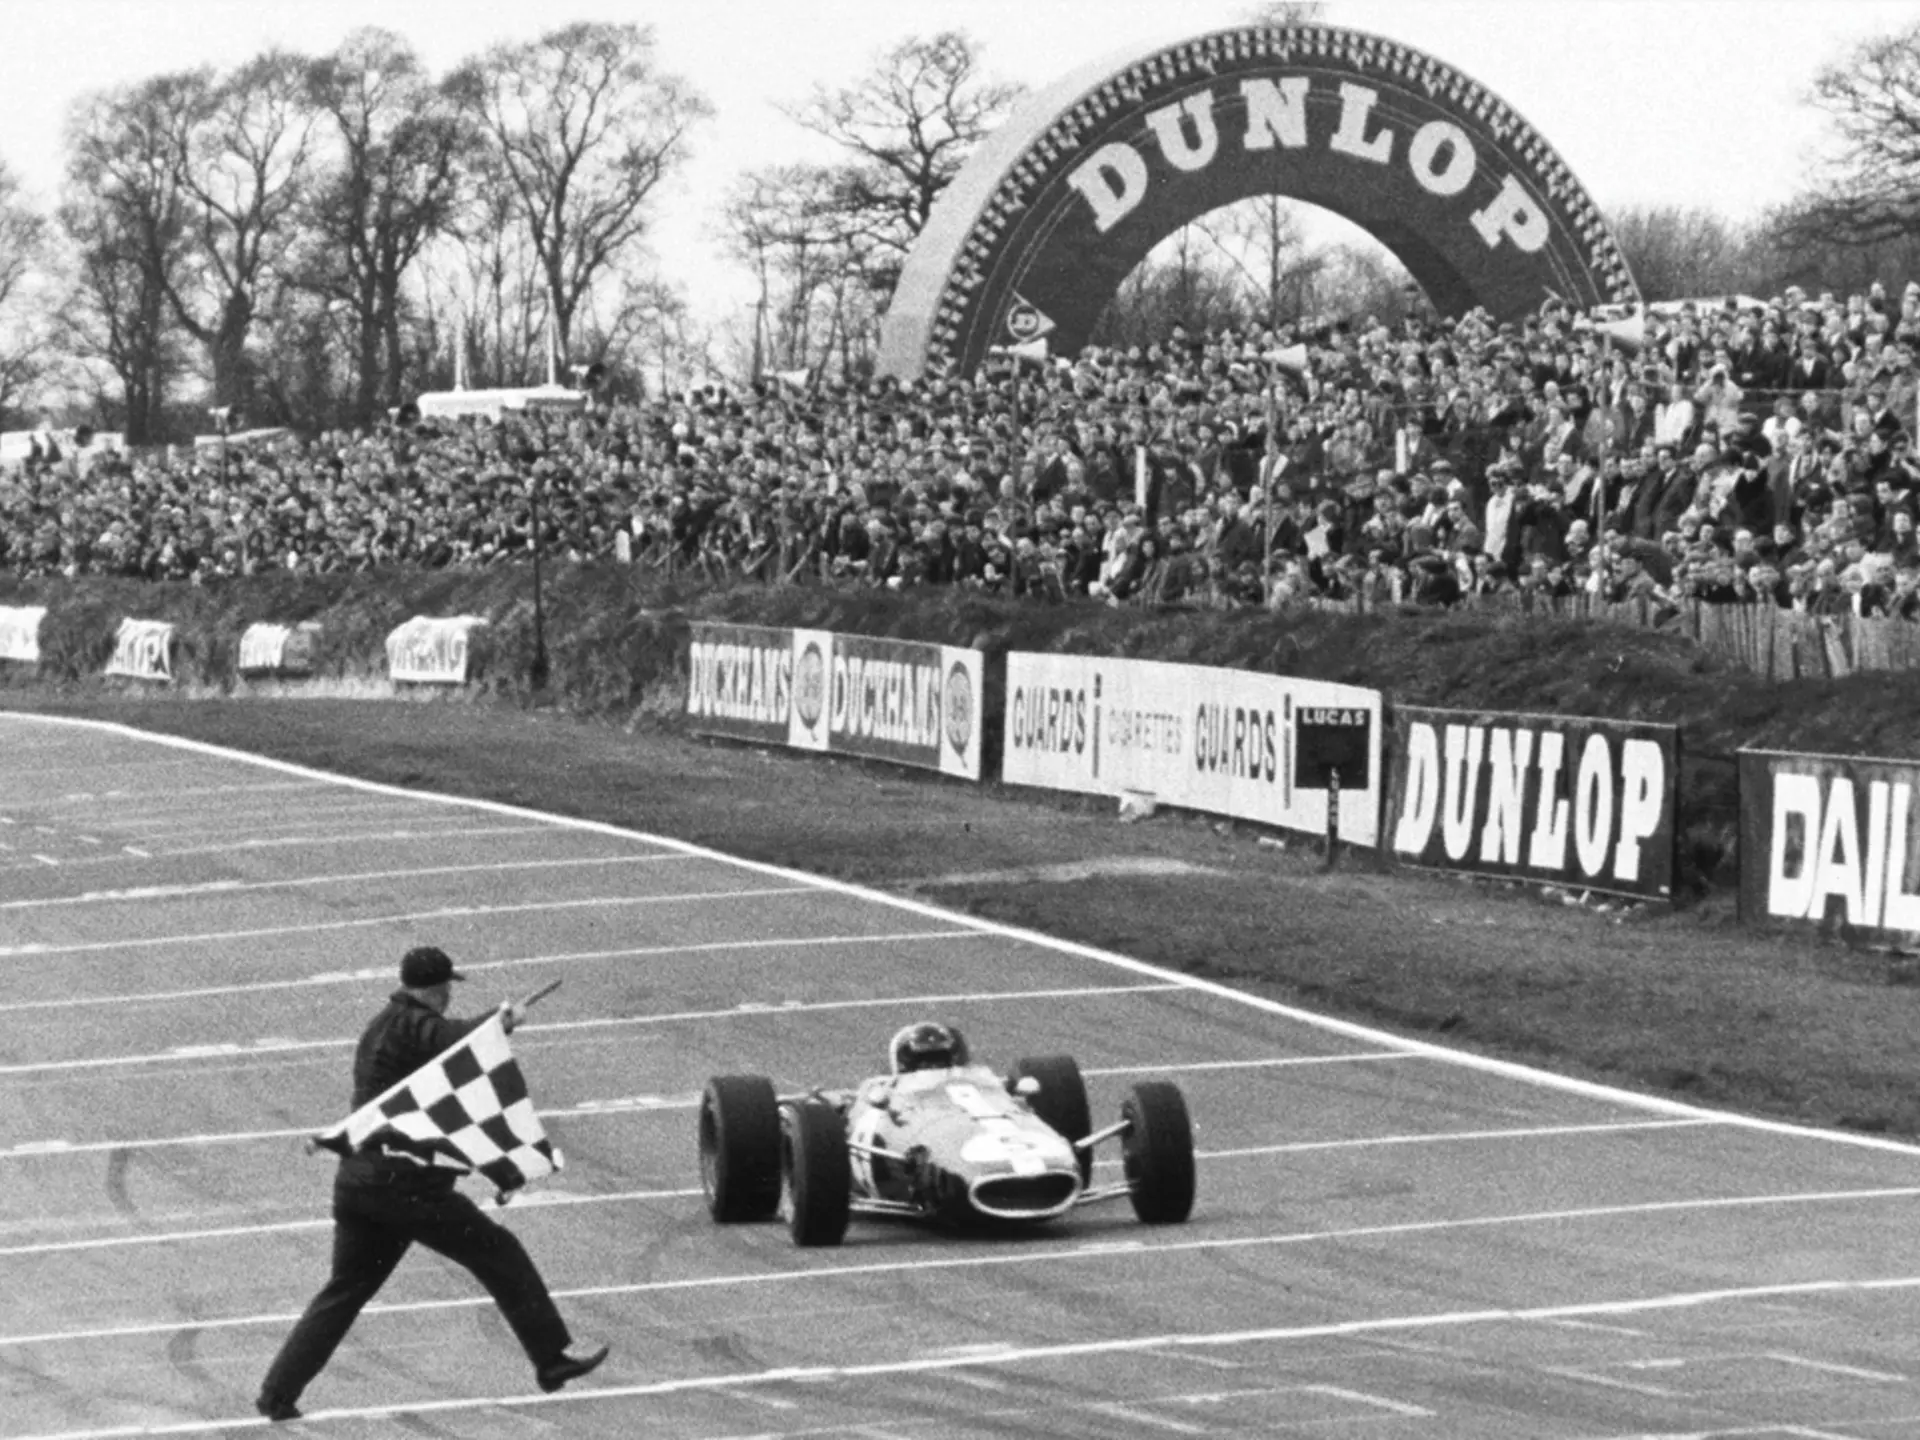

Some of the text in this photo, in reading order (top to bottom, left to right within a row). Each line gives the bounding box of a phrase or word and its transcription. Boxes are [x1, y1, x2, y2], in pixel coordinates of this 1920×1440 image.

[1067, 77, 1551, 253] DUNLOP
[687, 641, 791, 724] DUCKHAMS
[830, 655, 939, 748] DUCKHAMS
[1013, 686, 1086, 755] GUARDS
[1195, 703, 1276, 783] GUARDS
[1302, 709, 1365, 726] LUCAS
[1394, 722, 1664, 881] DUNLOP
[1768, 773, 1920, 932] DAIL
